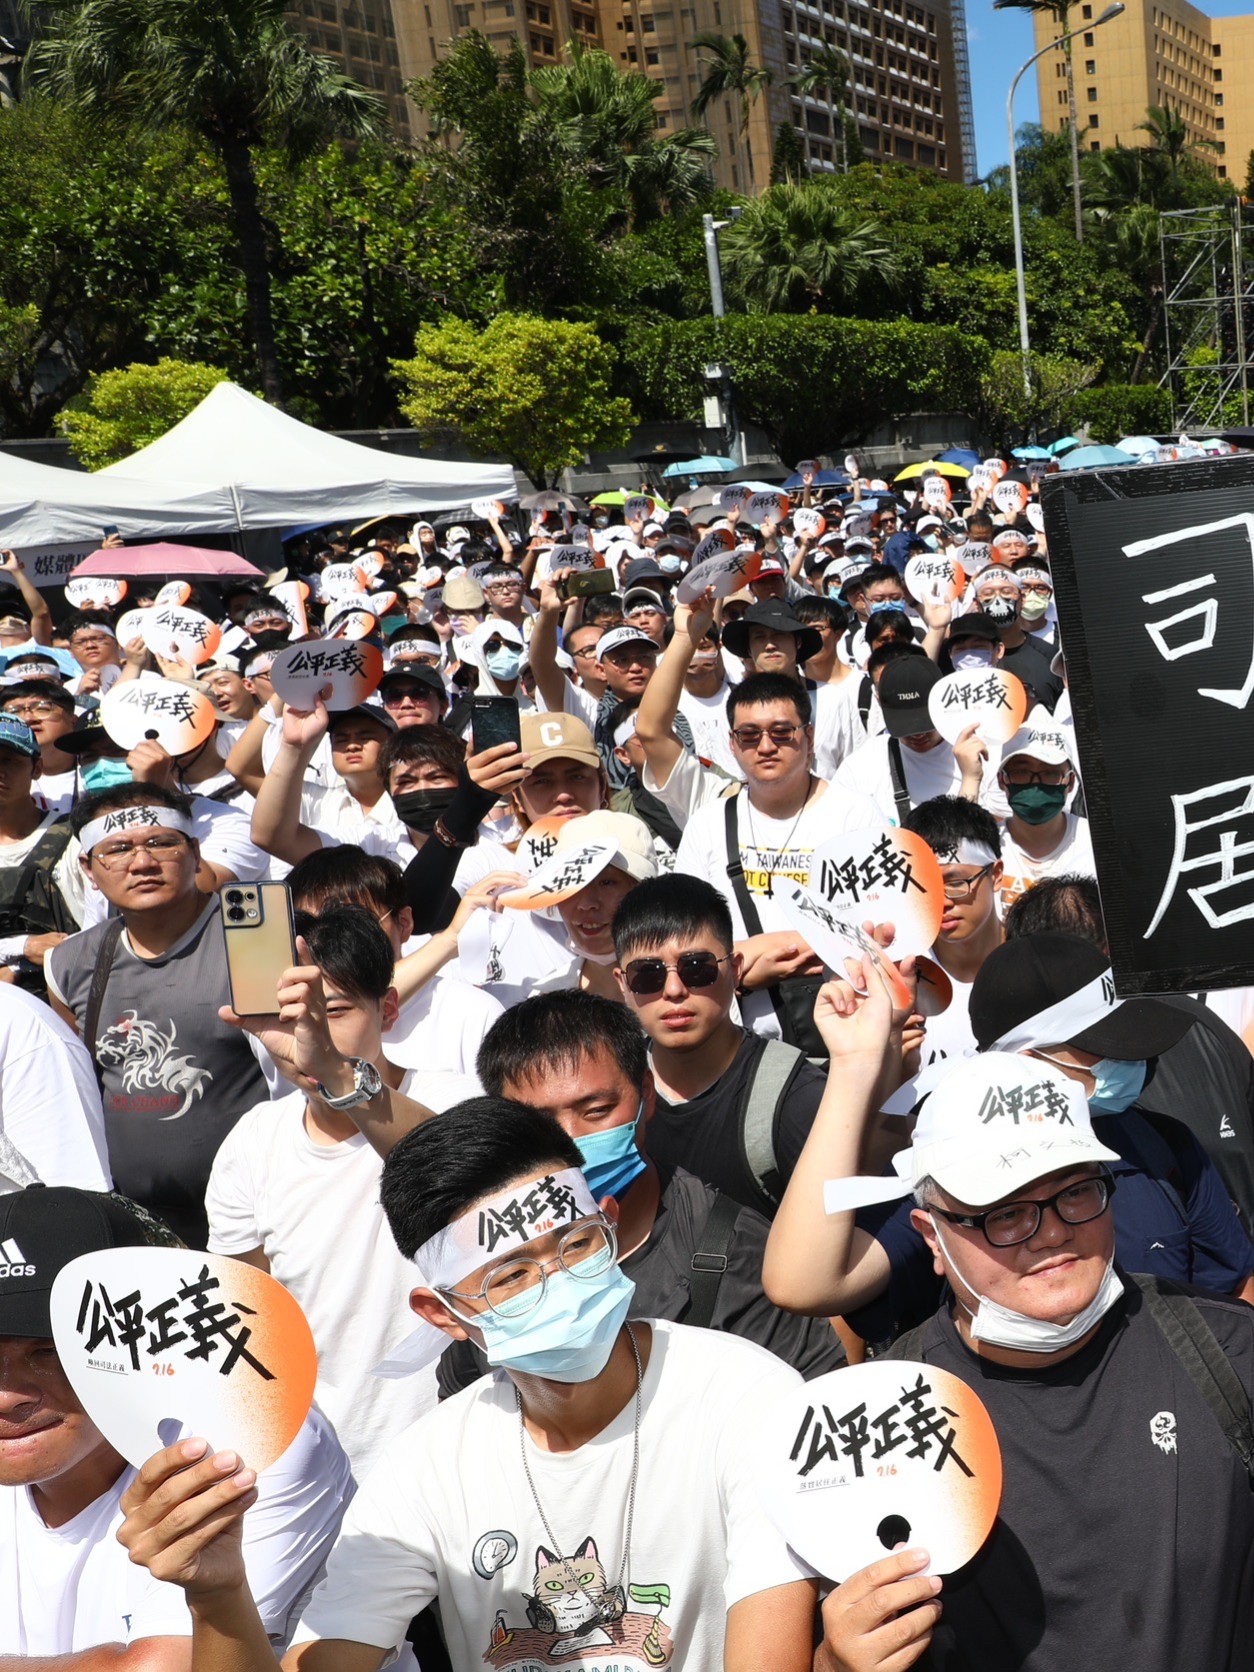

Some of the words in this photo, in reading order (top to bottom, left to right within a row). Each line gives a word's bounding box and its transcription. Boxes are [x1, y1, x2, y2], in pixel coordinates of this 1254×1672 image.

[751, 493, 783, 510] 公平正義
[557, 549, 597, 569] 公平正義
[962, 545, 993, 561] 公平正義
[328, 569, 361, 586] 公平正義
[914, 560, 956, 586] 公平正義
[156, 610, 209, 648] 公平正義
[287, 644, 368, 679] 公平正義
[941, 672, 1013, 711] 公平正義
[119, 690, 197, 729] 公平正義
[540, 722, 564, 746] C
[1027, 729, 1066, 750] 公平正義
[104, 805, 161, 834] 公平正義
[820, 834, 927, 903] 公平正義
[978, 1079, 1075, 1127] 公平正義
[478, 1175, 587, 1253] 公平正義
[76, 1264, 278, 1381] 公平正義
[152, 1362, 175, 1377] 7.16
[789, 1373, 976, 1478] 公平正義
